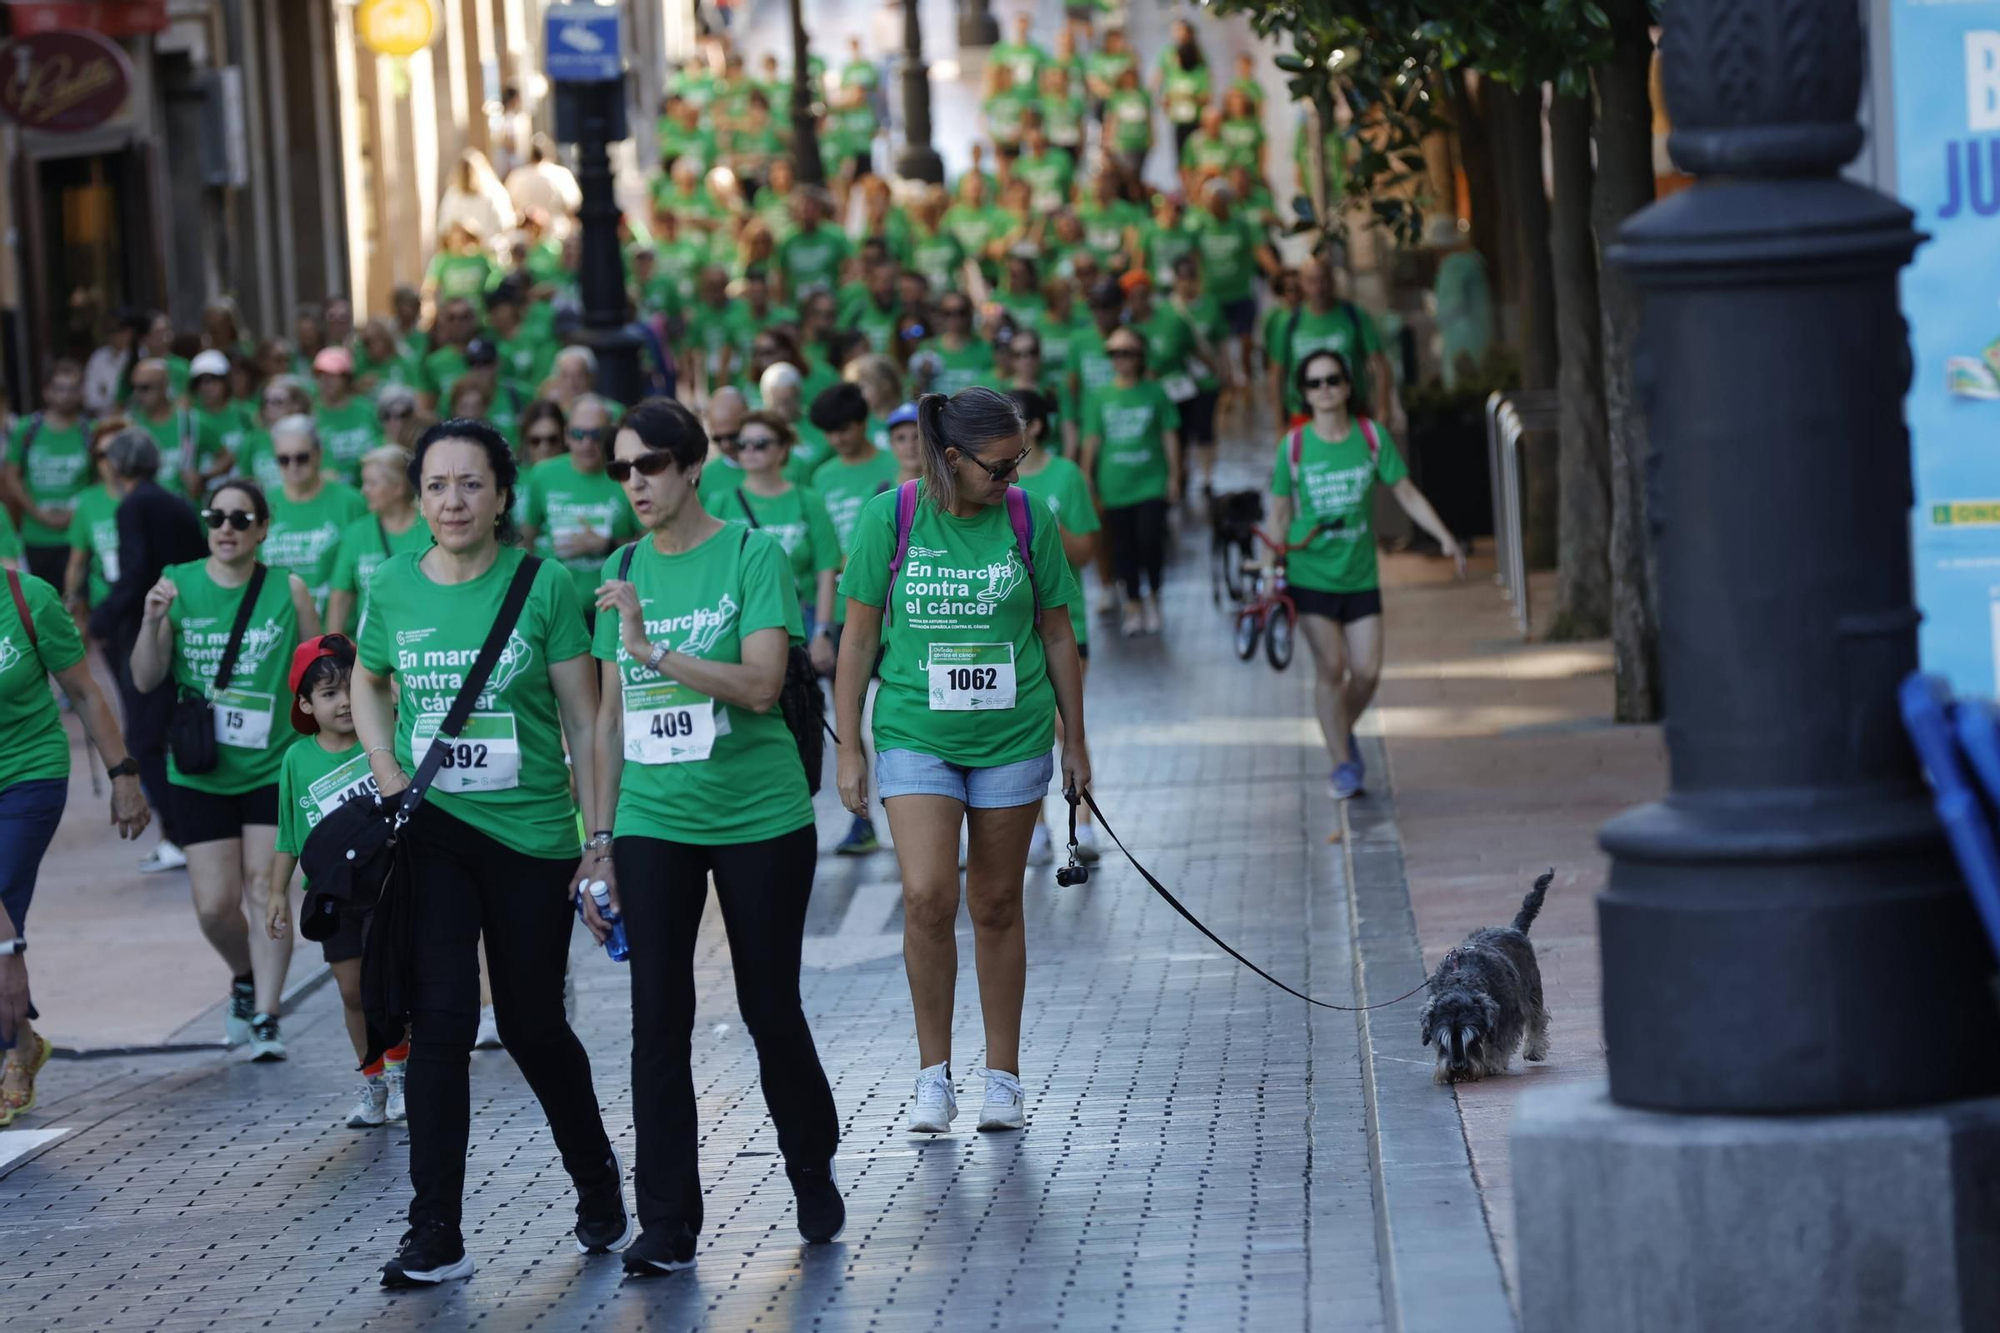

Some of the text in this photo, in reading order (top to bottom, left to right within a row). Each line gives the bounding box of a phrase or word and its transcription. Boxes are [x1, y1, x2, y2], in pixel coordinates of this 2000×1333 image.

[906, 561, 1013, 580] En marcha
[905, 580, 969, 597] contra
[905, 598, 998, 616] el cáncer
[643, 609, 722, 635] marcha
[183, 630, 204, 646] En
[398, 650, 418, 670] En
[403, 670, 463, 690] contra
[947, 667, 998, 691] 1062
[225, 711, 244, 729] 15
[651, 710, 693, 739] 409
